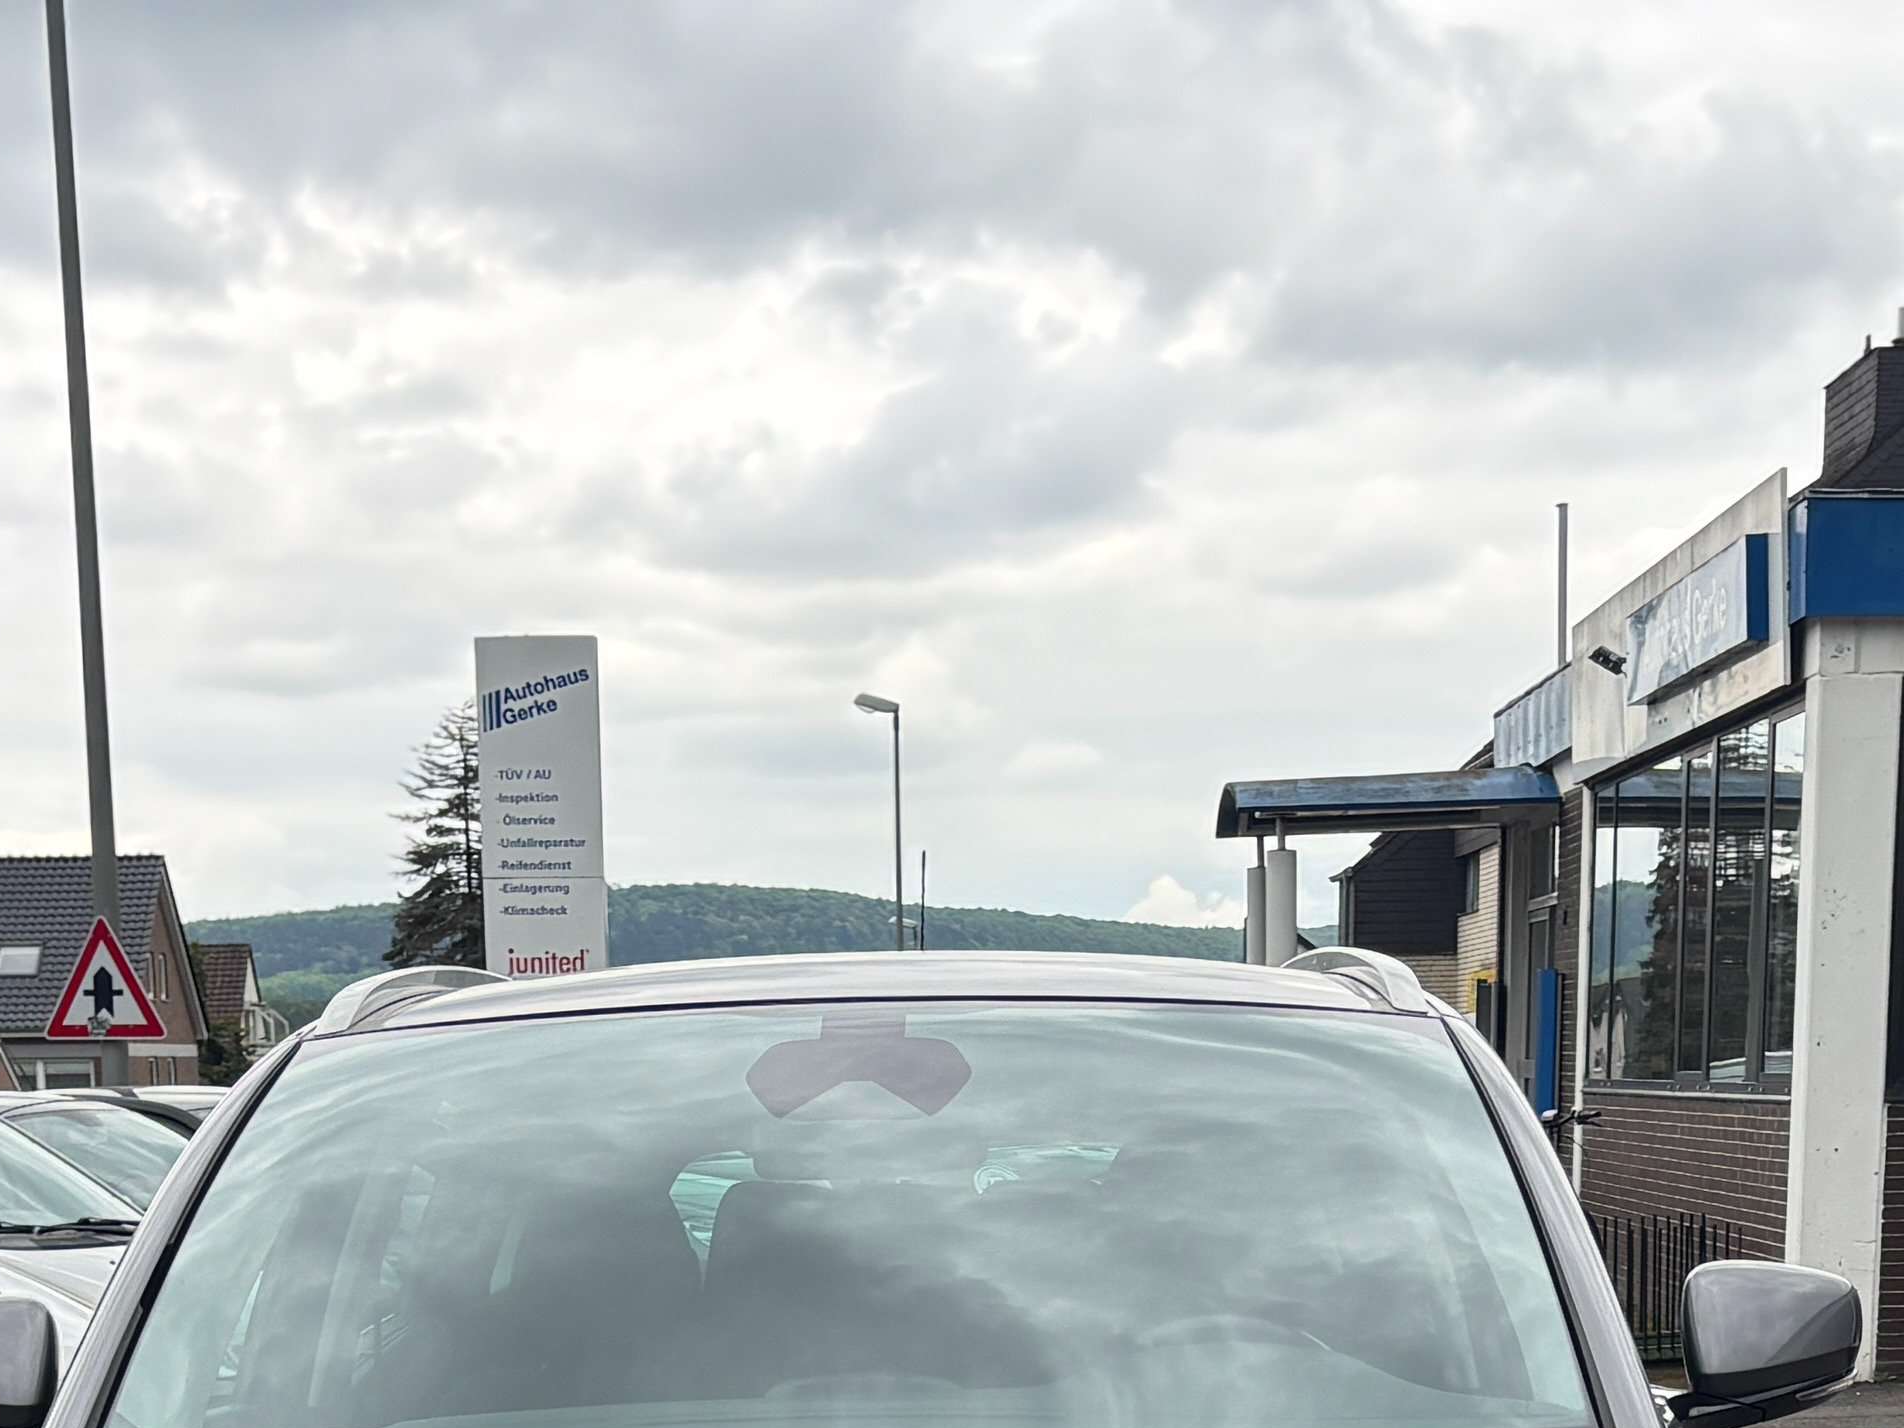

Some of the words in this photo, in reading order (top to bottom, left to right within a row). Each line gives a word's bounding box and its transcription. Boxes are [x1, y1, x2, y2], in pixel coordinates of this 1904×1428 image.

[503, 668, 590, 704] Autohaus
[502, 699, 558, 725] Gerke
[534, 769, 551, 780] AU
[507, 947, 585, 977] junited
